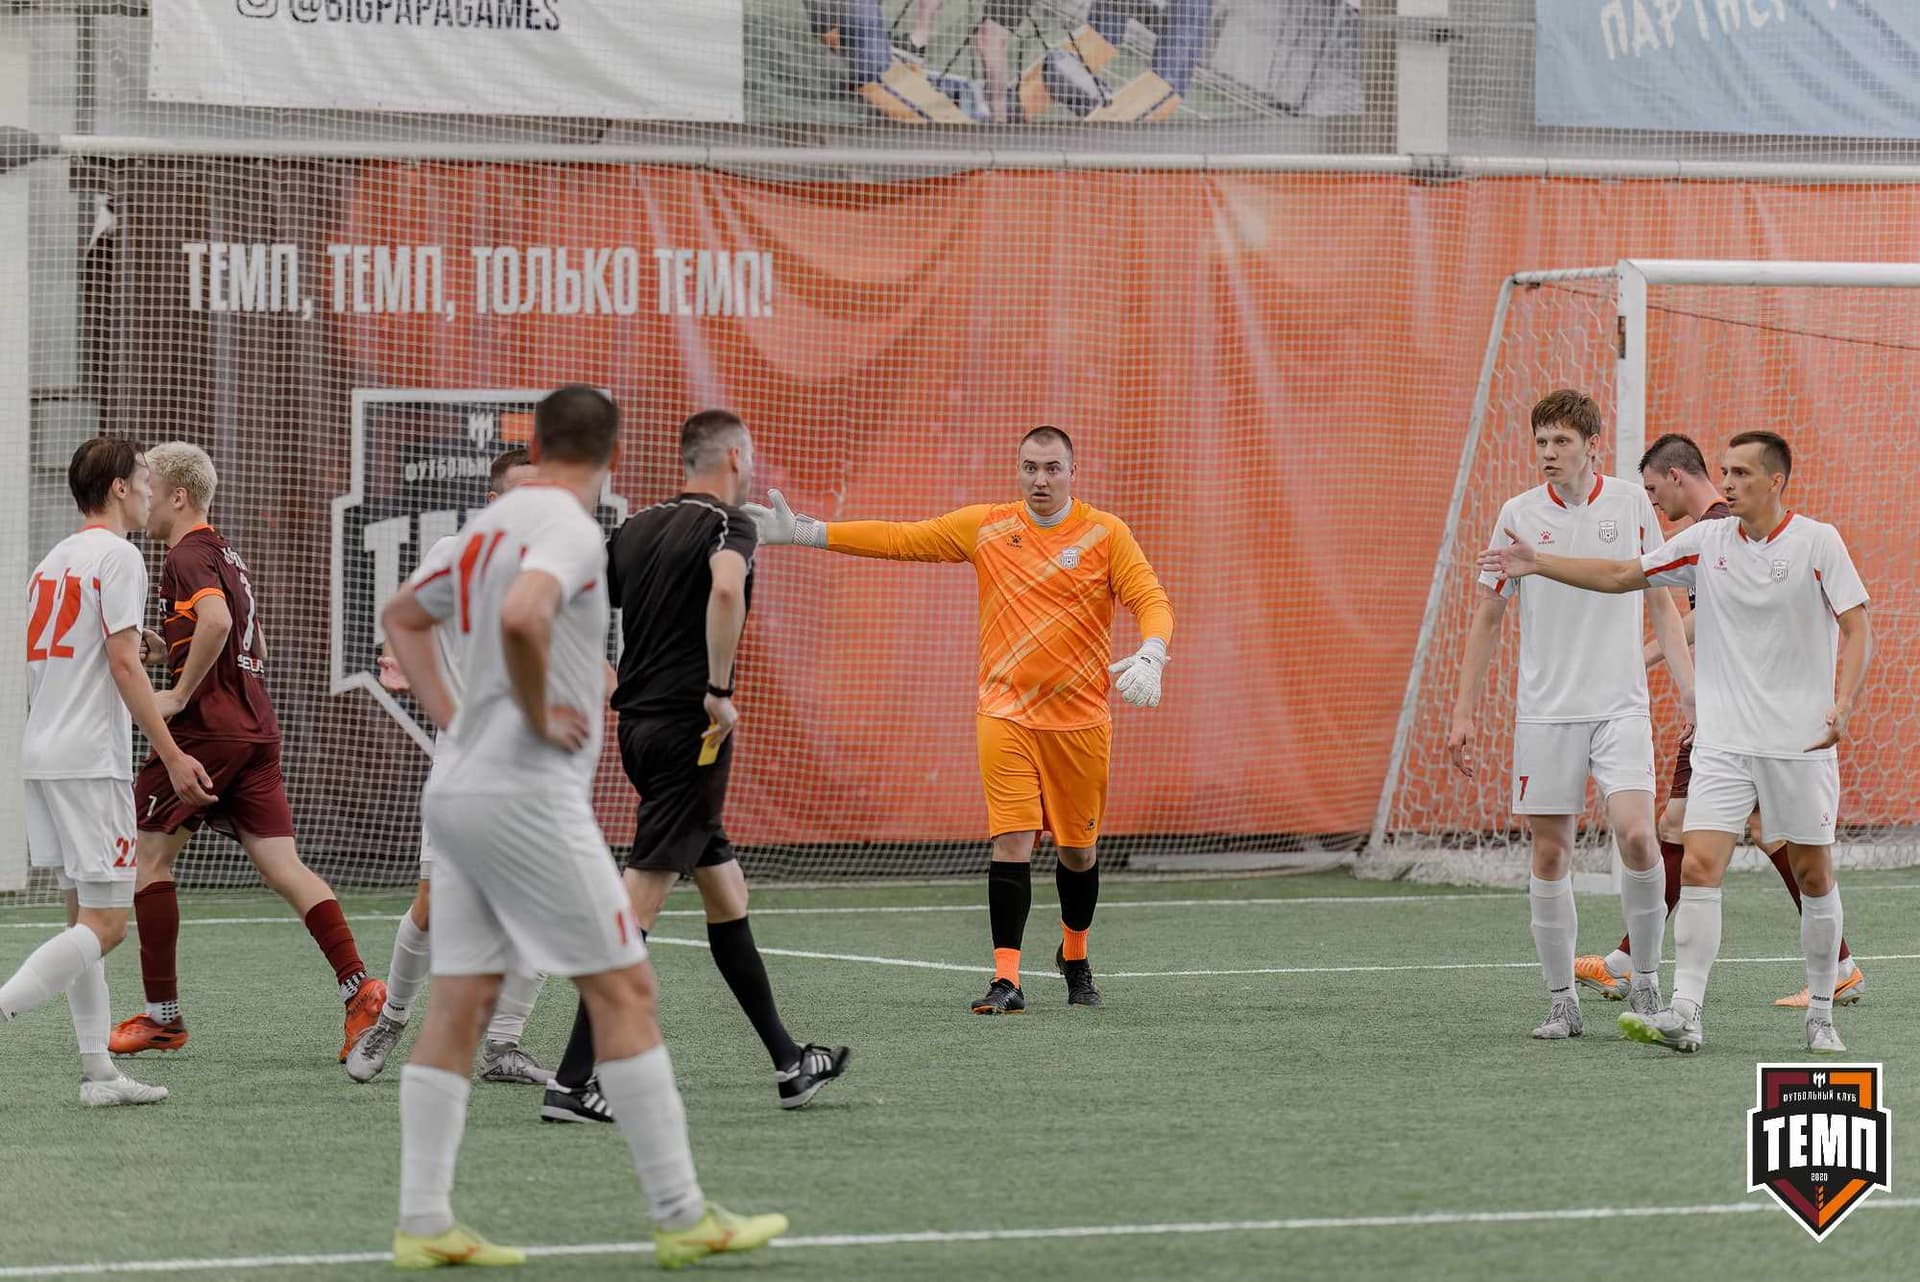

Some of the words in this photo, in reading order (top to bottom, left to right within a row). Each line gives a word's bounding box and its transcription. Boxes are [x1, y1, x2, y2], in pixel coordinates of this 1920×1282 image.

[182, 242, 313, 320] ТЕМП,
[327, 244, 455, 321] ТЕМП,
[471, 246, 638, 316] ТОЛЬКО
[653, 248, 773, 318] ТЕМП!
[27, 567, 81, 662] 22
[147, 795, 157, 817] 7
[1519, 775, 1530, 801] 7
